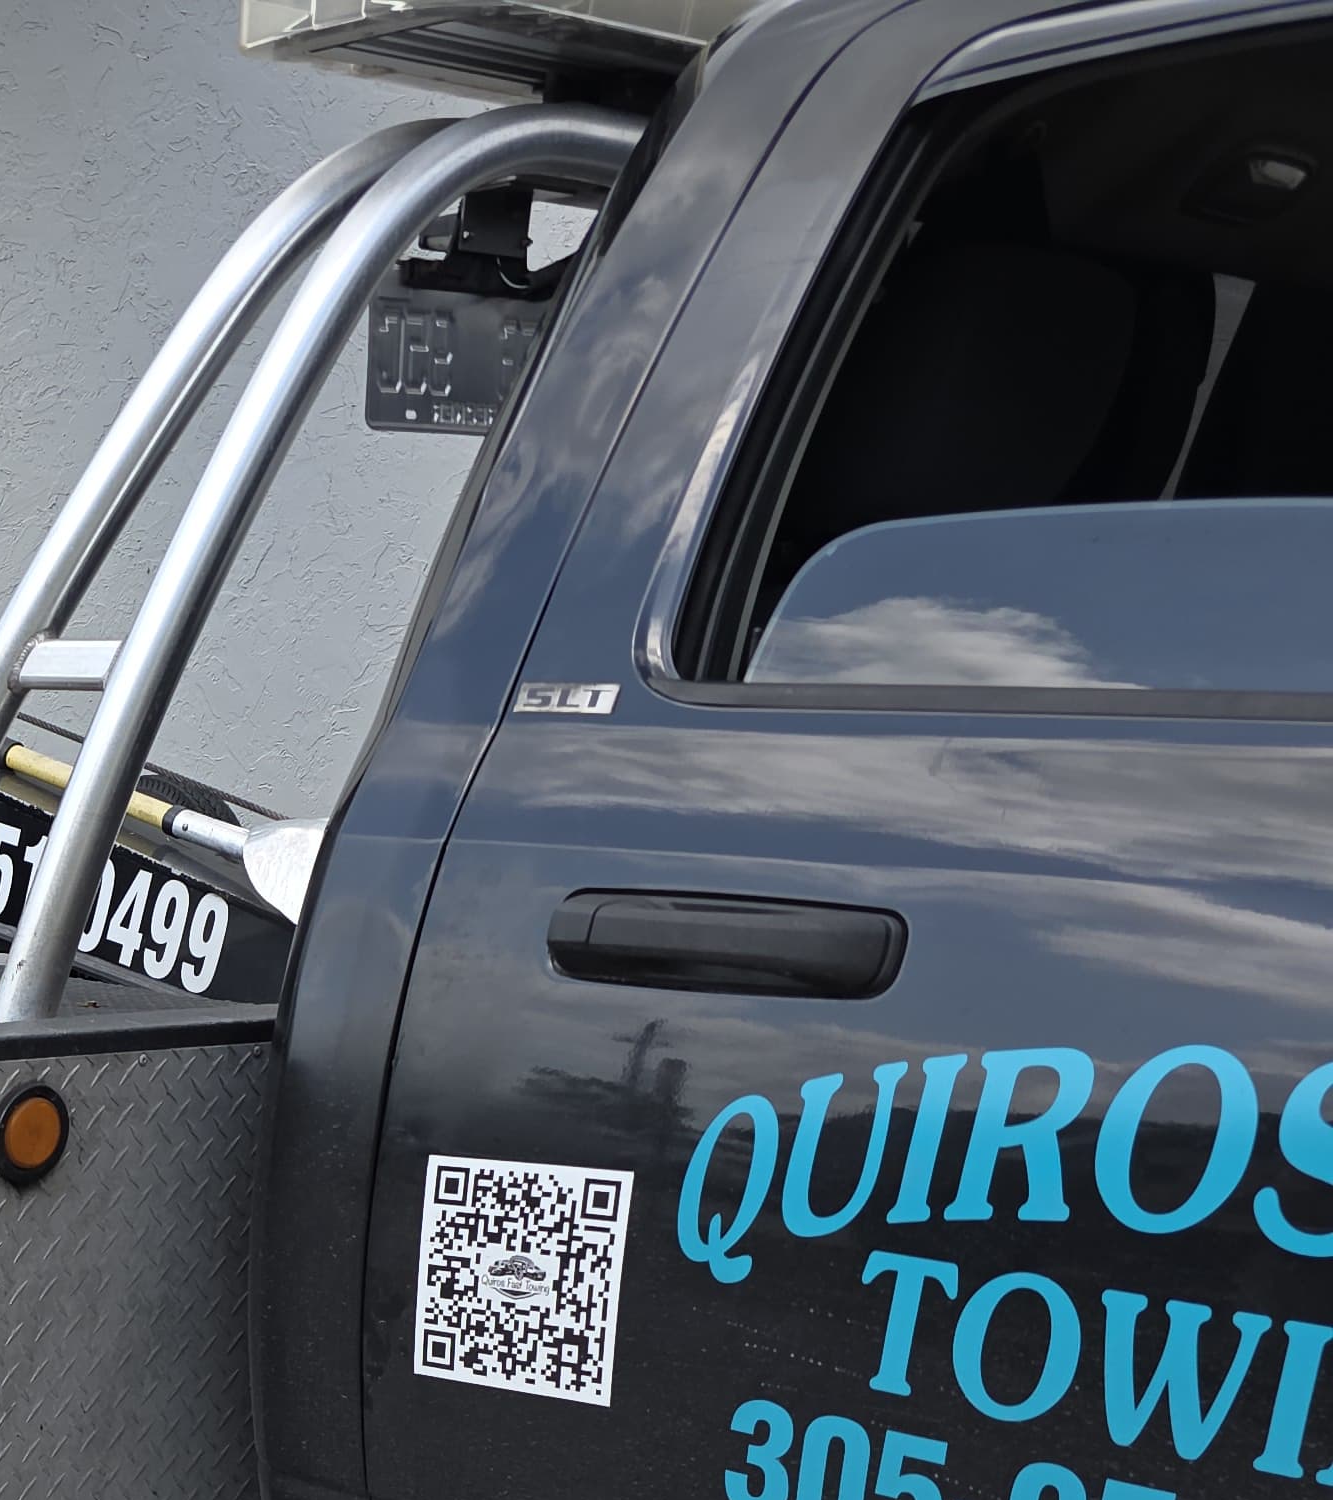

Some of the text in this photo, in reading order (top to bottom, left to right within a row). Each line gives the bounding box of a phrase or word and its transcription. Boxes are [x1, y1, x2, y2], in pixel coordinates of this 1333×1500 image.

[522, 687, 614, 708] SLT
[678, 1042, 1333, 1283] QUIROS
[525, 1280, 550, 1296] Towing
[862, 1251, 1333, 1487] TOWI
